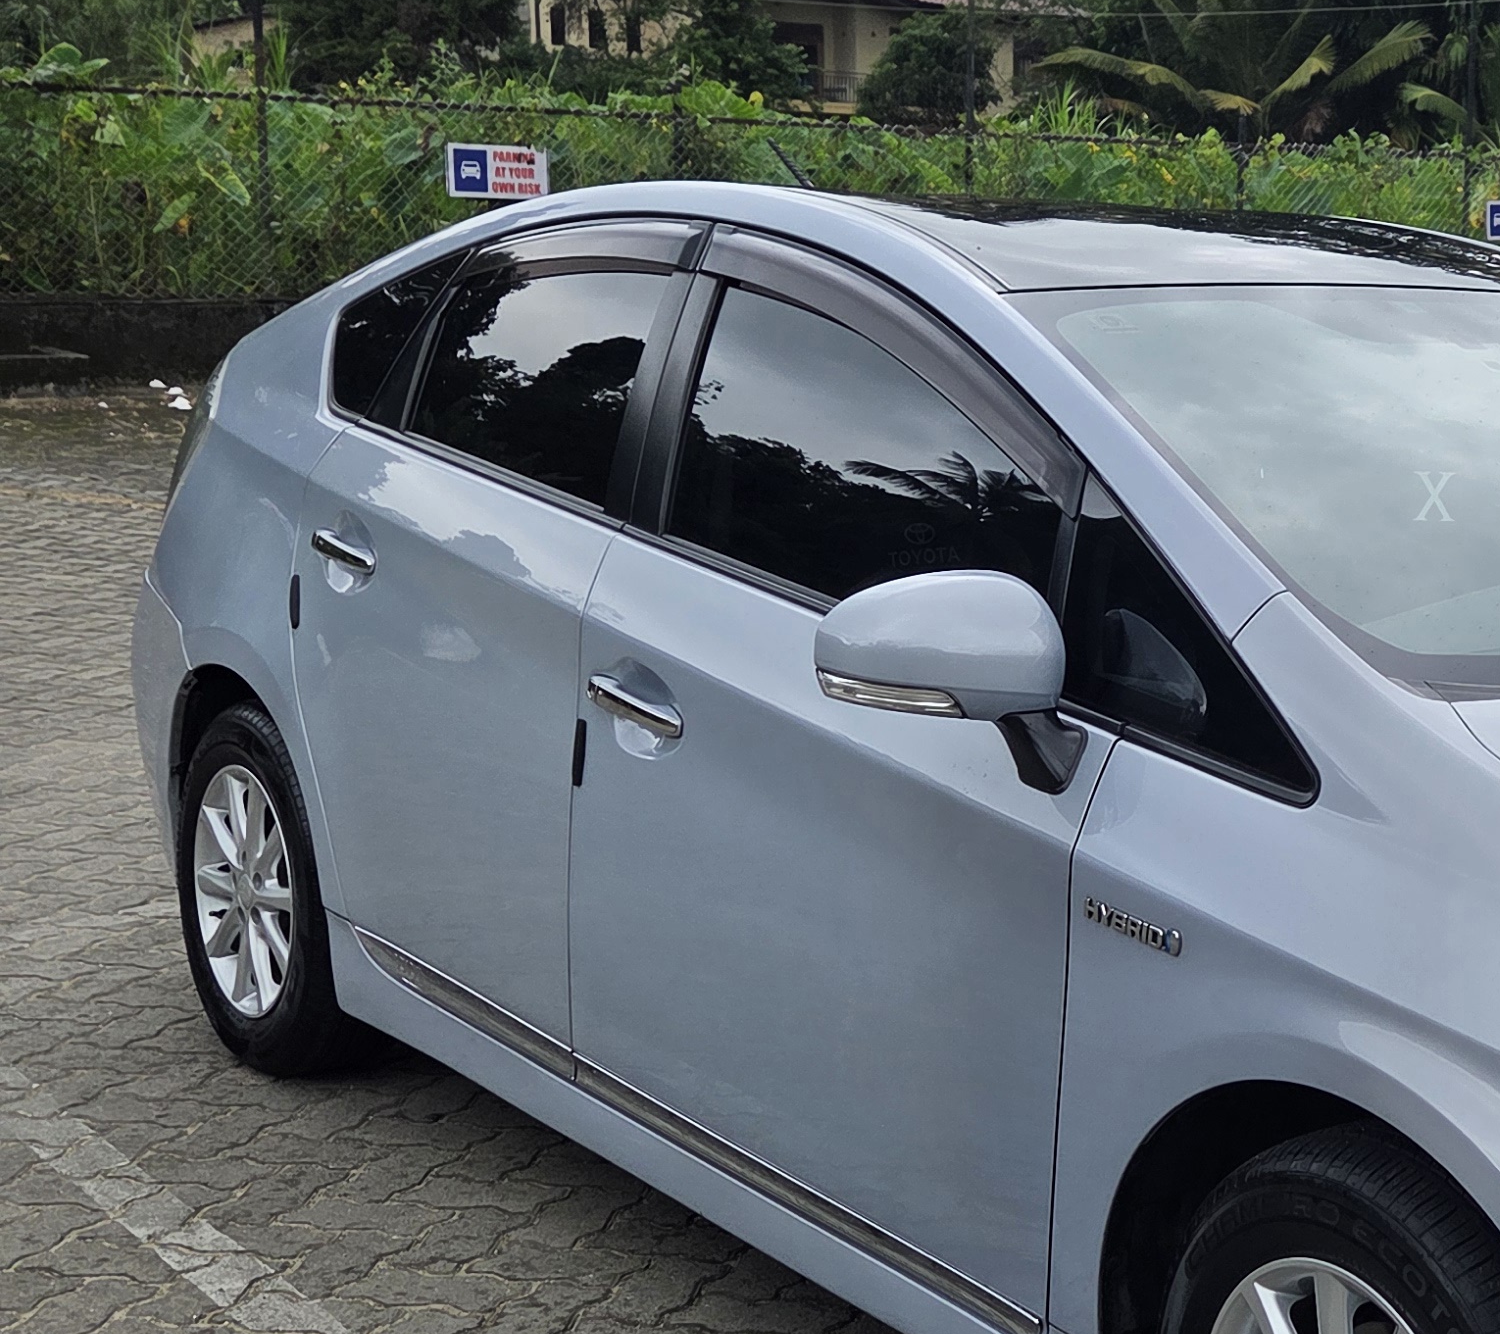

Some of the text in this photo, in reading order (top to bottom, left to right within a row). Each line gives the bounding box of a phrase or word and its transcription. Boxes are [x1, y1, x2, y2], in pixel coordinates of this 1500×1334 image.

[495, 166, 535, 179] AT YOUR
[492, 181, 541, 195] OWN RISK
[1413, 470, 1456, 522] X
[888, 547, 960, 567] TOYOTA
[1084, 896, 1164, 950] HYBRID
